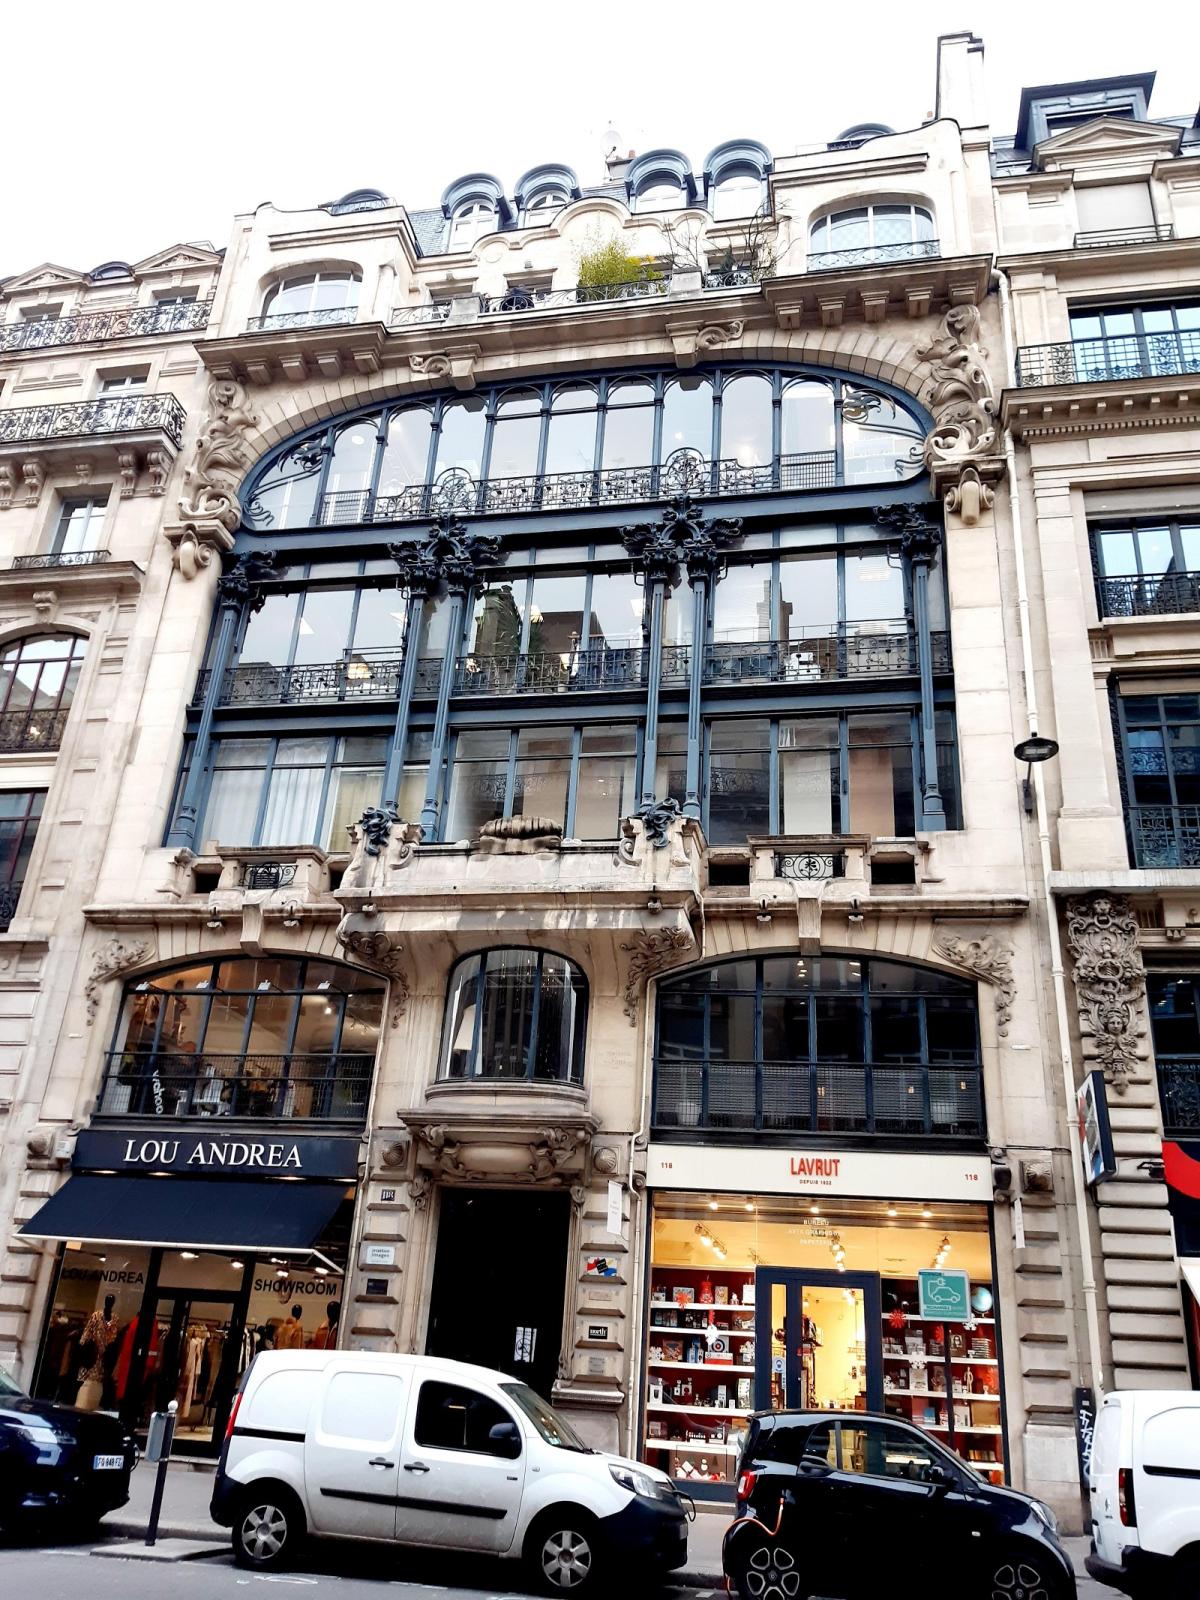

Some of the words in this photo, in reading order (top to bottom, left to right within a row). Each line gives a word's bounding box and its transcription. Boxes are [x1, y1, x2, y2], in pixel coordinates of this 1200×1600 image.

[123, 1139, 181, 1163] LOU
[187, 1141, 302, 1168] ANDREA
[661, 1161, 673, 1169] 118
[790, 1157, 840, 1177] LAVRUT
[964, 1173, 978, 1181] 118
[89, 1269, 144, 1284] ANDREA
[254, 1278, 337, 1296] SHOWROOM
